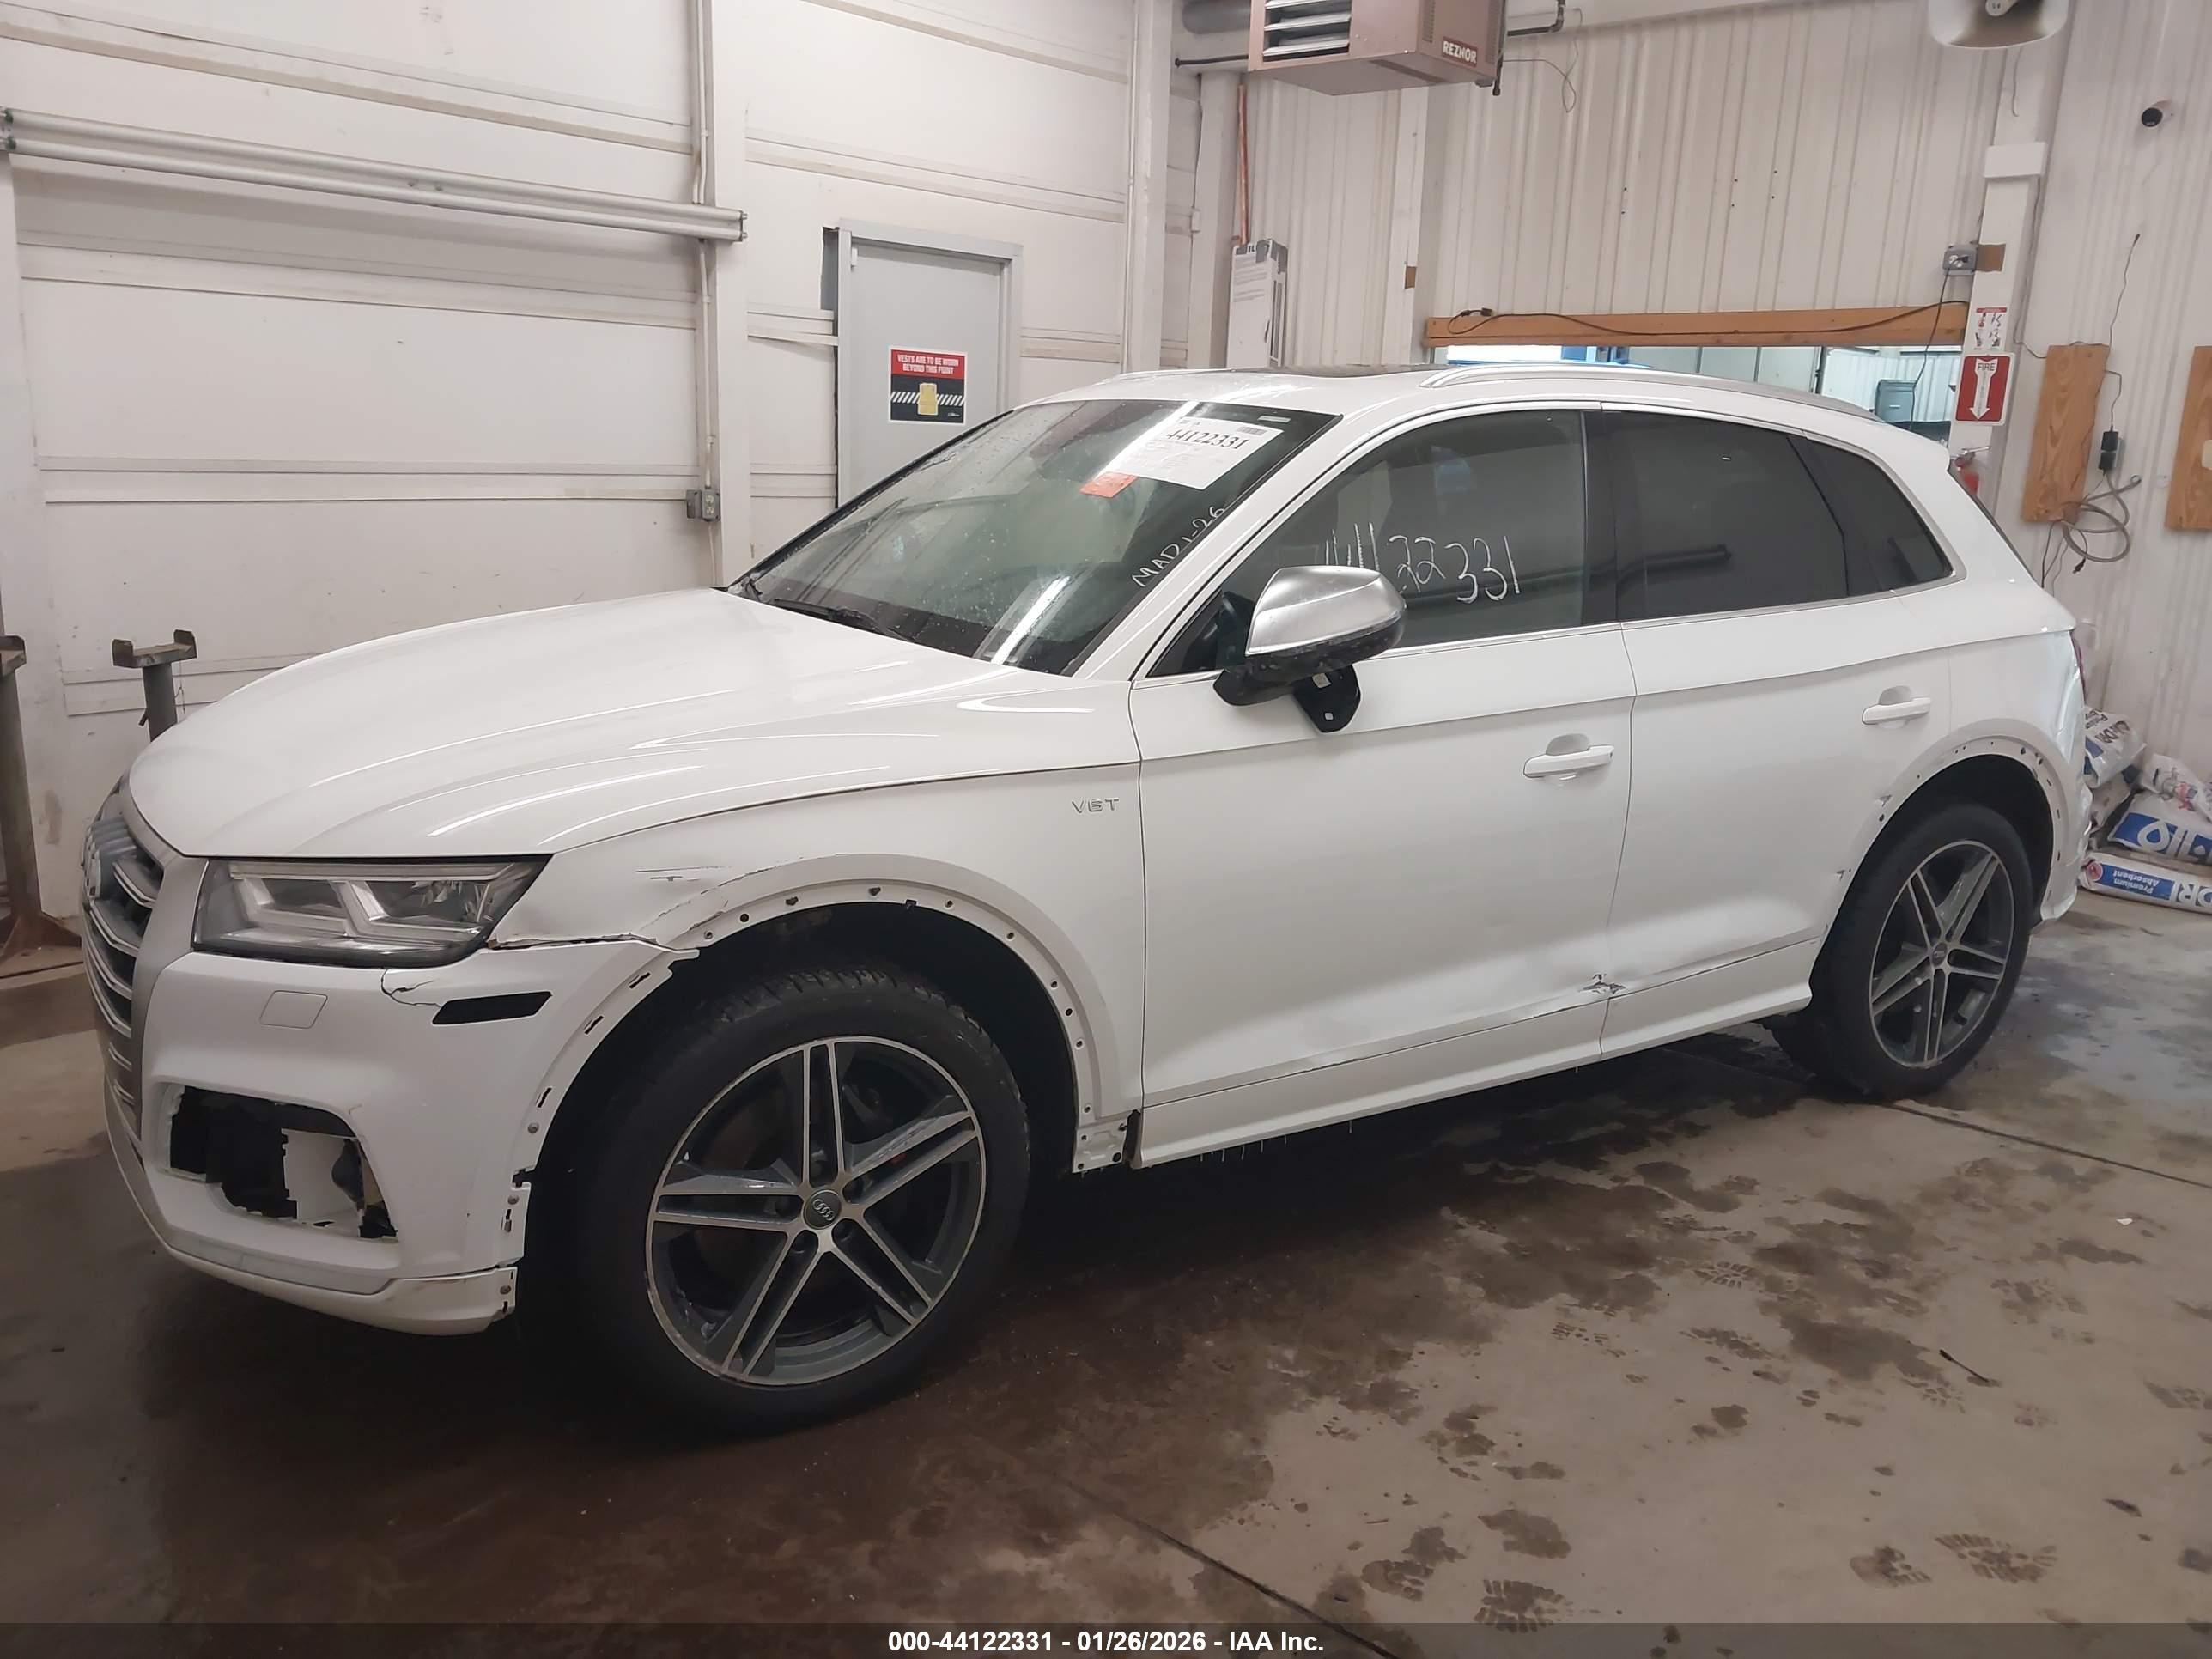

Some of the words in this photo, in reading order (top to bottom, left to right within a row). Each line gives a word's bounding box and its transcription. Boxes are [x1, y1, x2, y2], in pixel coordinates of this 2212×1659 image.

[1443, 40, 1477, 64] REZNOR
[897, 354, 915, 363] VESTS
[915, 356, 927, 364] ARE
[927, 356, 934, 365] TO
[934, 357, 942, 366] BE
[902, 363, 925, 373] BEYOND
[1977, 362, 1996, 372] FIRE
[1167, 429, 1249, 449] 44122331
[2112, 870, 2161, 887] Absorbent
[2113, 878, 2154, 894] Premium
